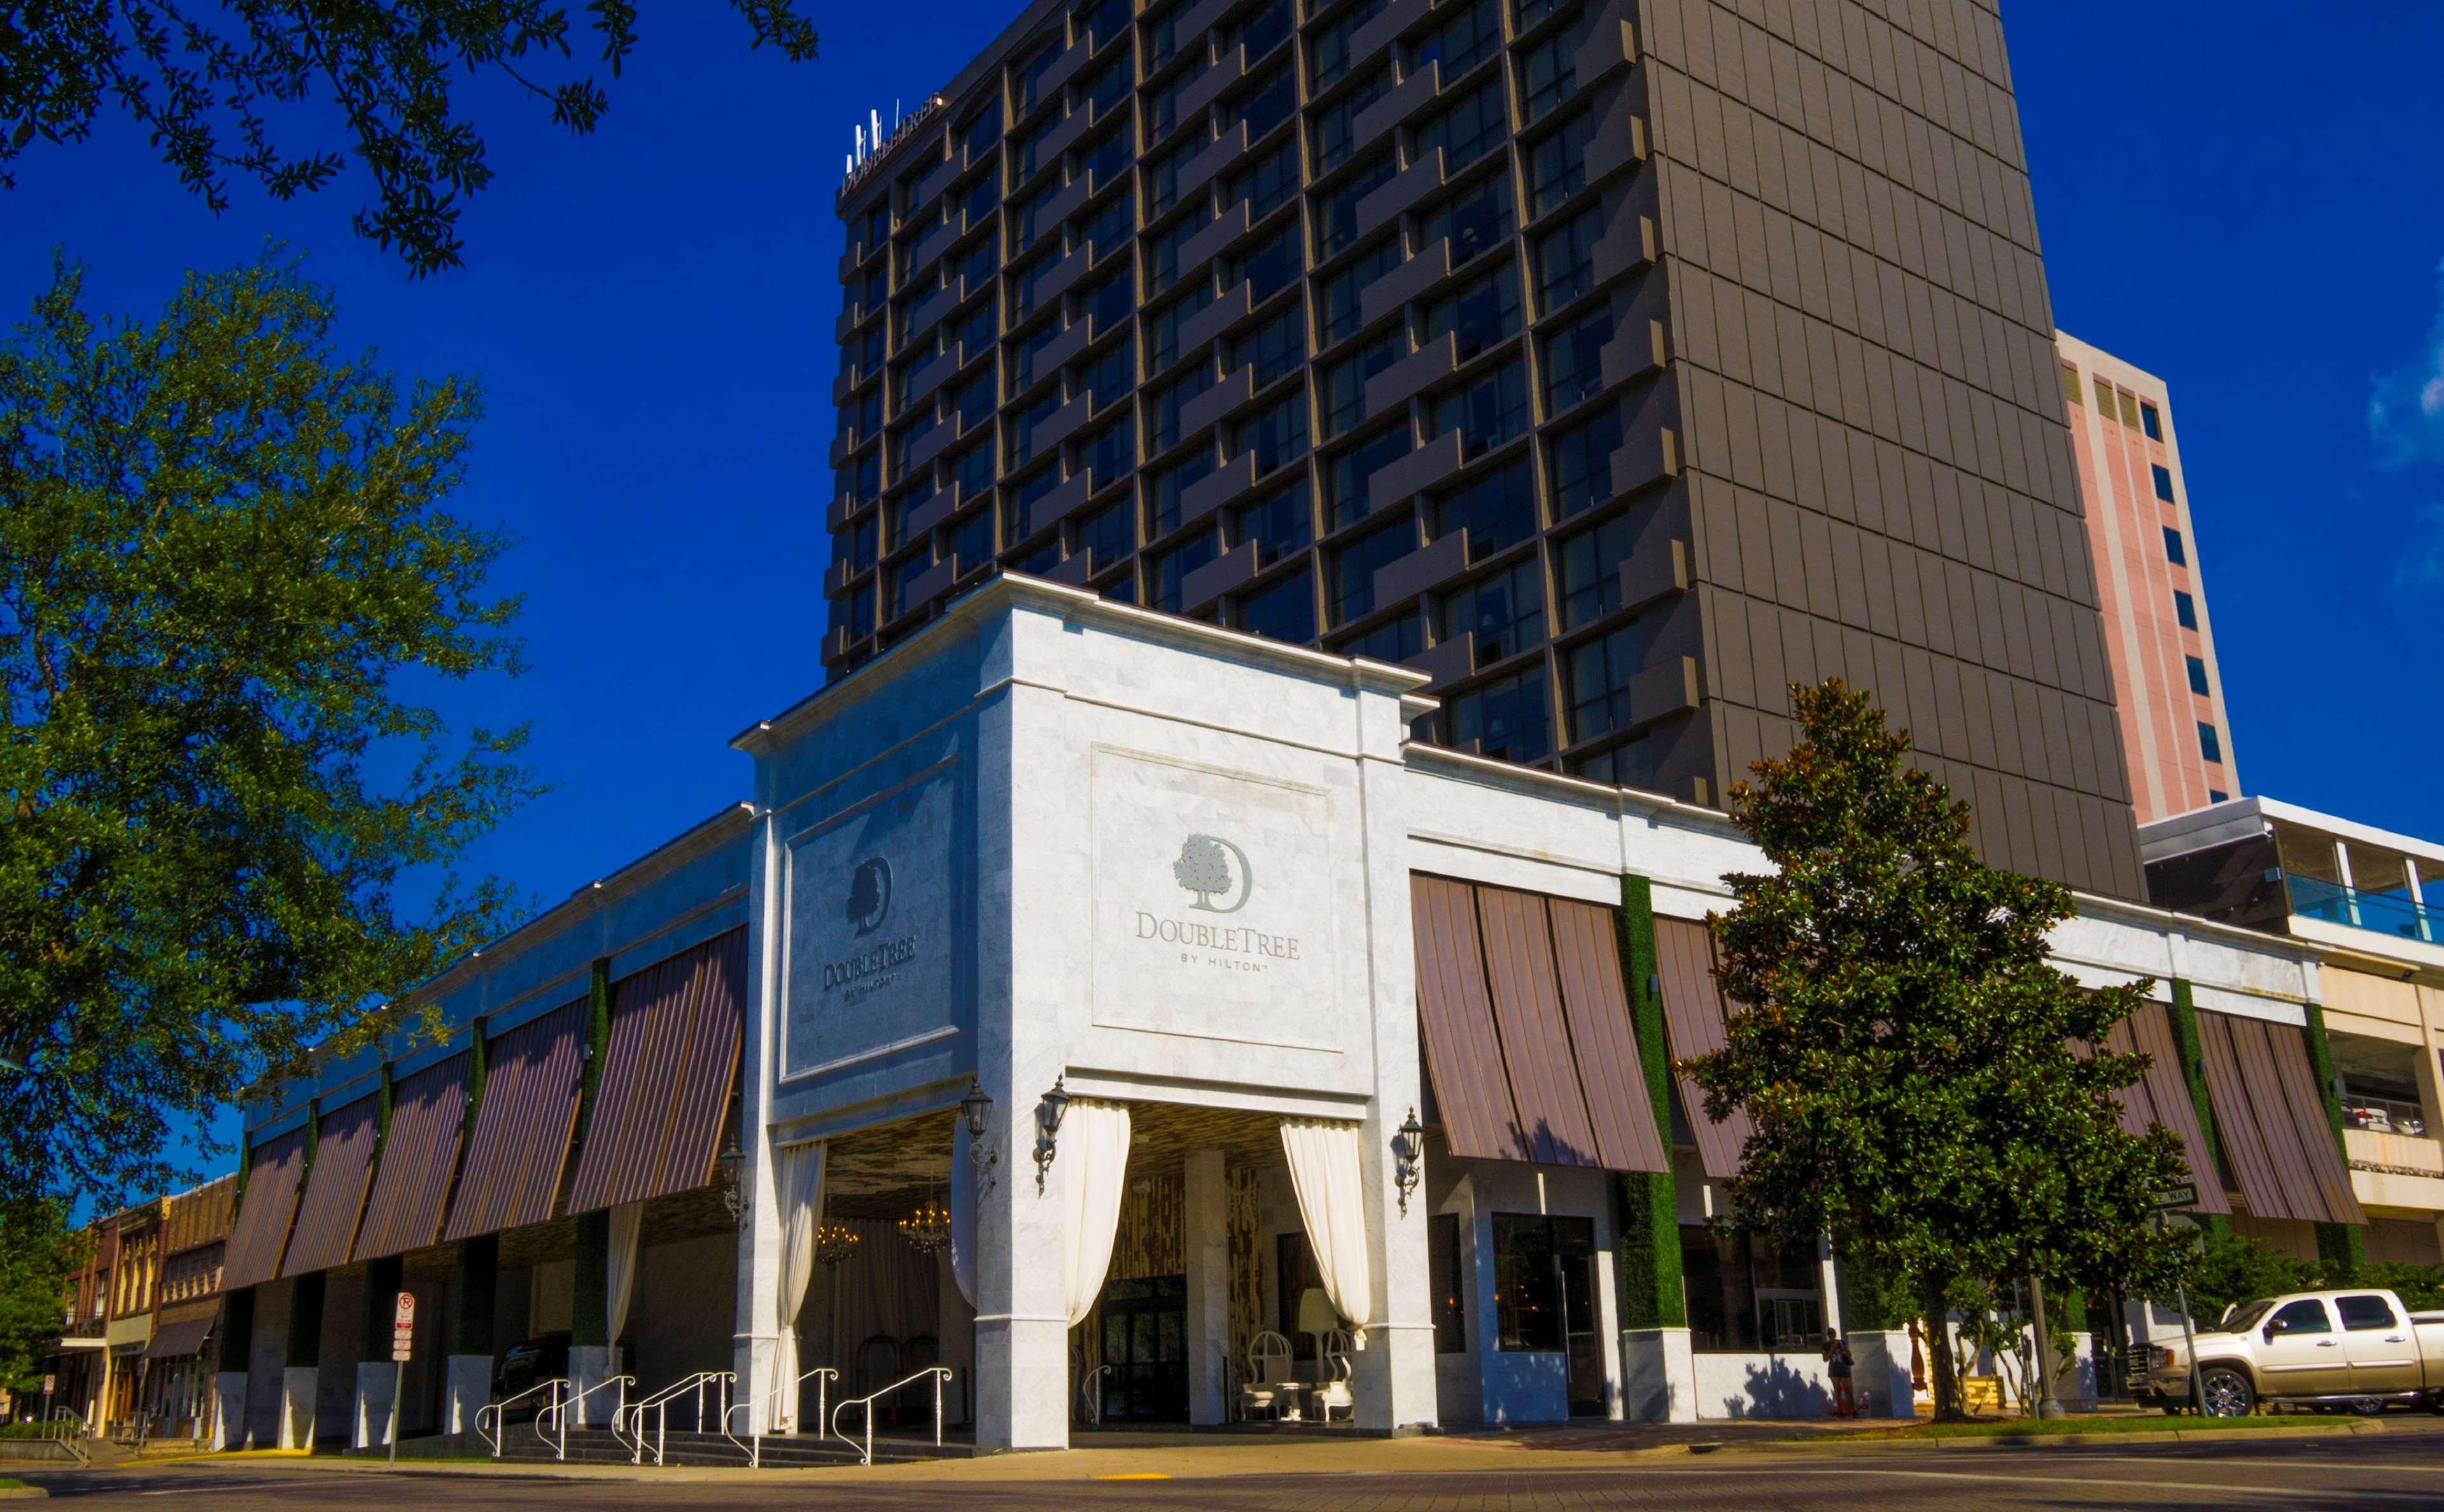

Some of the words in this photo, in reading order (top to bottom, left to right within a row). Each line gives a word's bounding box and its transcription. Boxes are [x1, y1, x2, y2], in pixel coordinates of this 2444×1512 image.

[1135, 911, 1300, 961] DOUBLETREE
[825, 934, 916, 991] DOUBLETREE
[1181, 953, 1198, 963] BY
[2169, 1190, 2189, 1201] WAY
